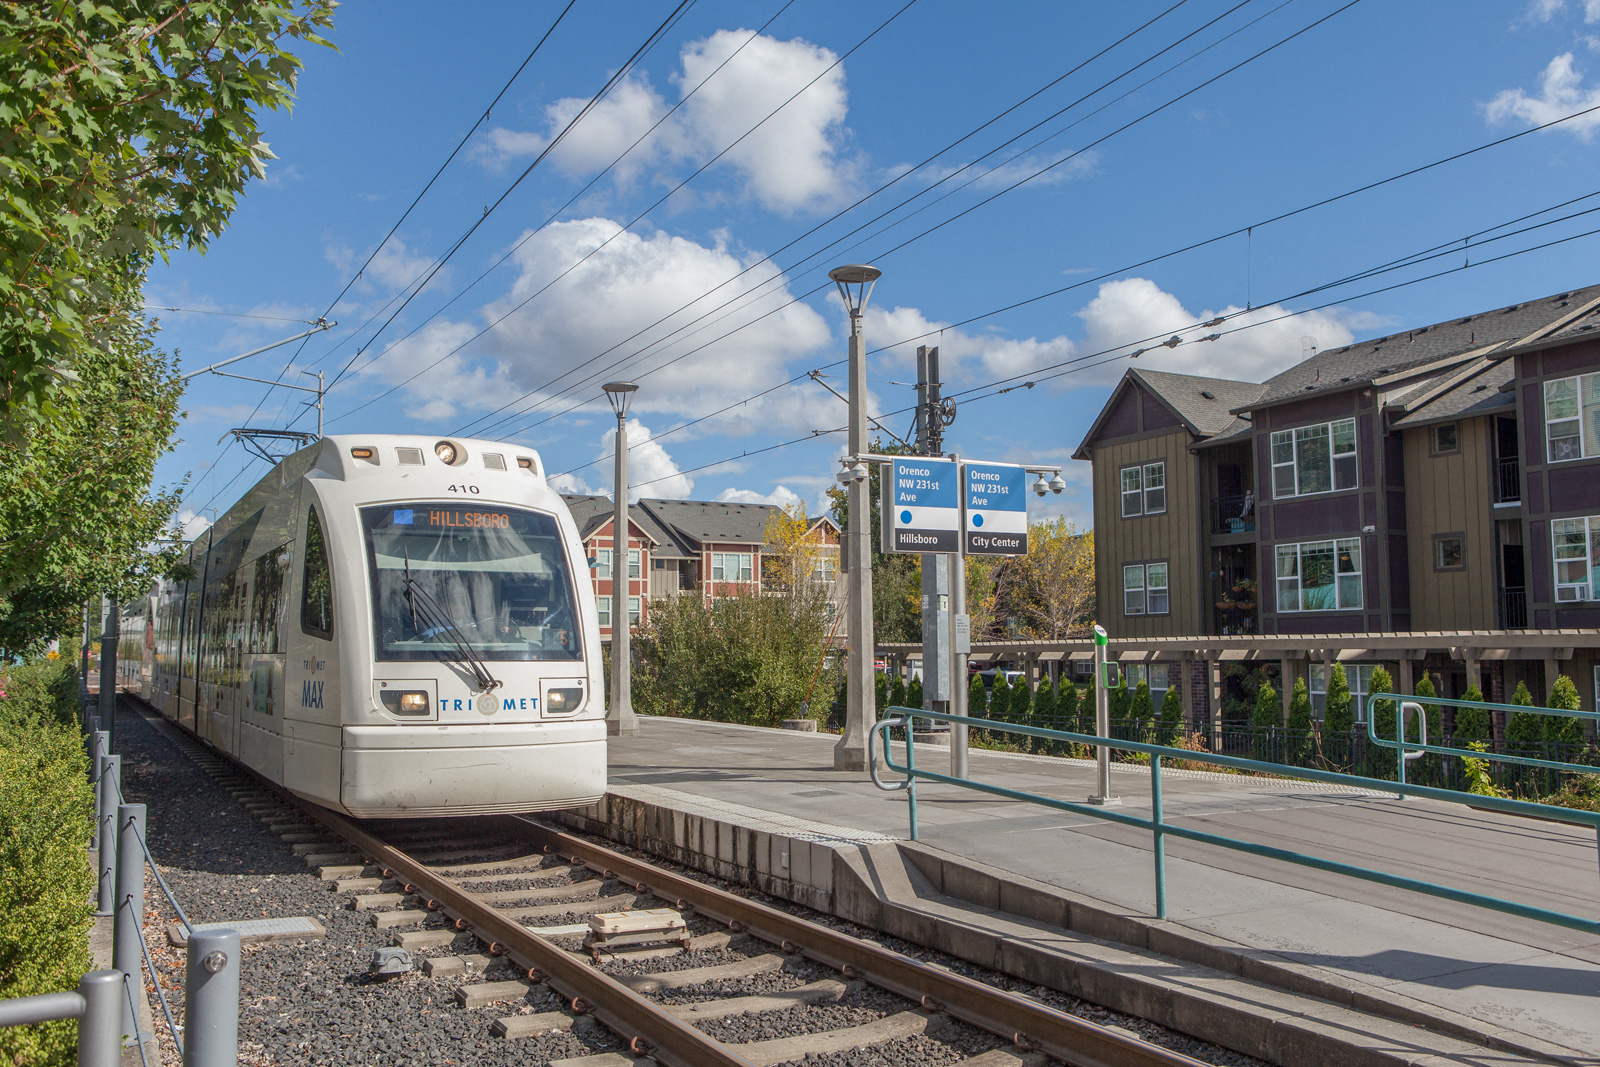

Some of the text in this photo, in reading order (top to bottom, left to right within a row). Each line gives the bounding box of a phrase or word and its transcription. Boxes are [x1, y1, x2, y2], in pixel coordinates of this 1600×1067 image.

[899, 465, 930, 476] Orenco
[971, 470, 1000, 481] Orenco
[448, 484, 480, 494] 410
[899, 479, 939, 490] NW 231st
[971, 483, 1009, 495] NW 231st
[900, 492, 917, 502] Ave
[971, 496, 988, 506] Ave
[430, 510, 509, 528] HILLSBORO
[900, 533, 938, 545] Hillsboro
[972, 536, 1020, 549] City Center
[302, 680, 324, 709] MAX
[440, 698, 538, 711] TRI MET
